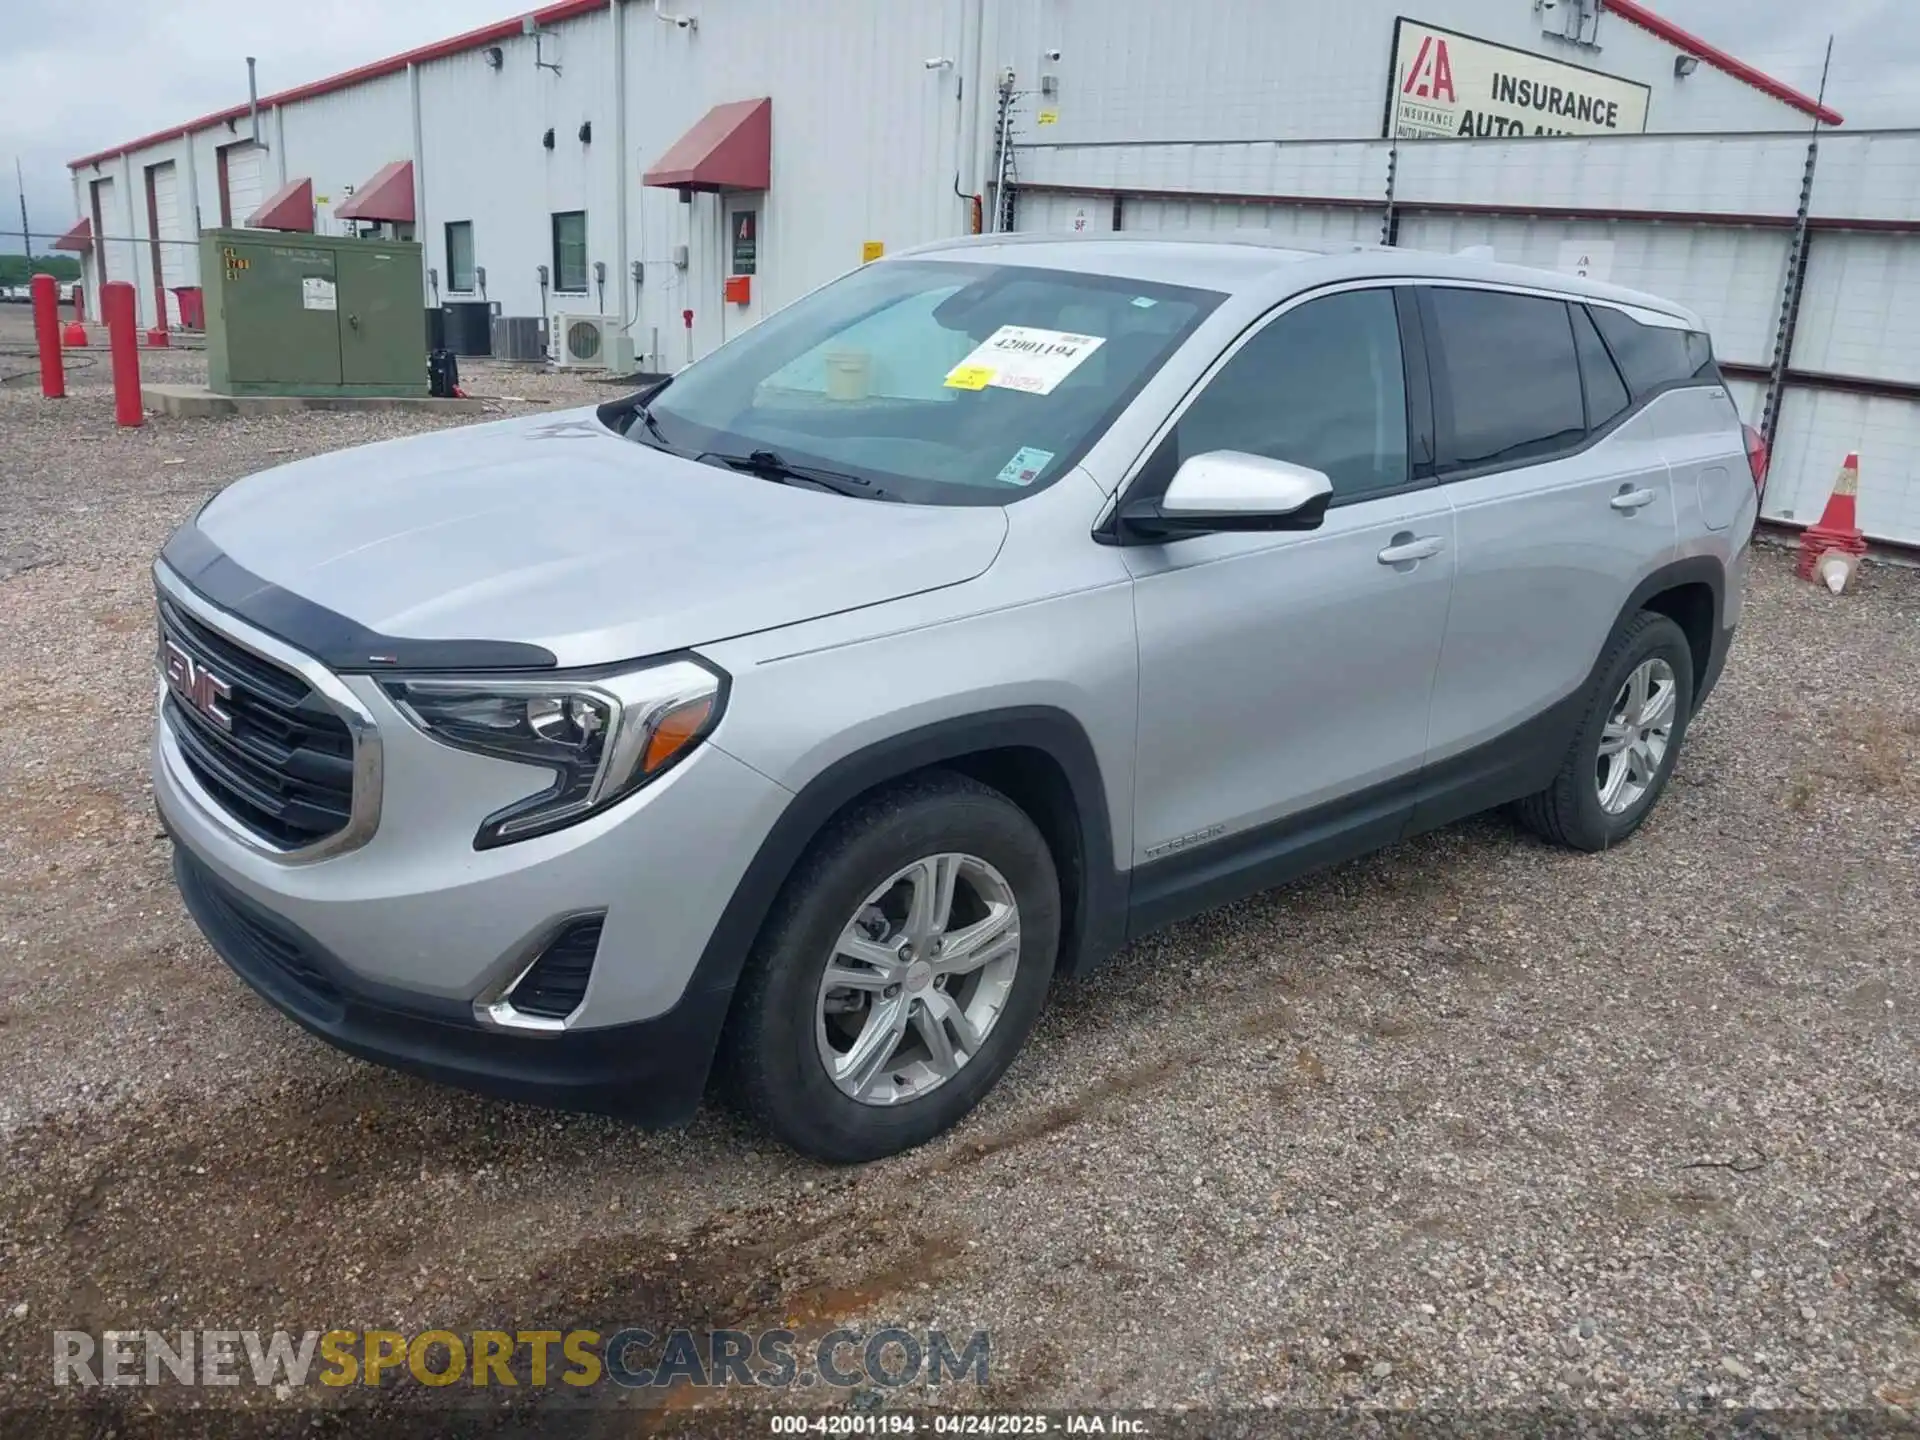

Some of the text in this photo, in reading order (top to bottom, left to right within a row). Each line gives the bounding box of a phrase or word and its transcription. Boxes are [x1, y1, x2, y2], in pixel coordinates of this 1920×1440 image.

[1492, 73, 1618, 128] INSURANCE
[1400, 105, 1453, 127] INSURANCE
[1457, 109, 1524, 137] AUTO
